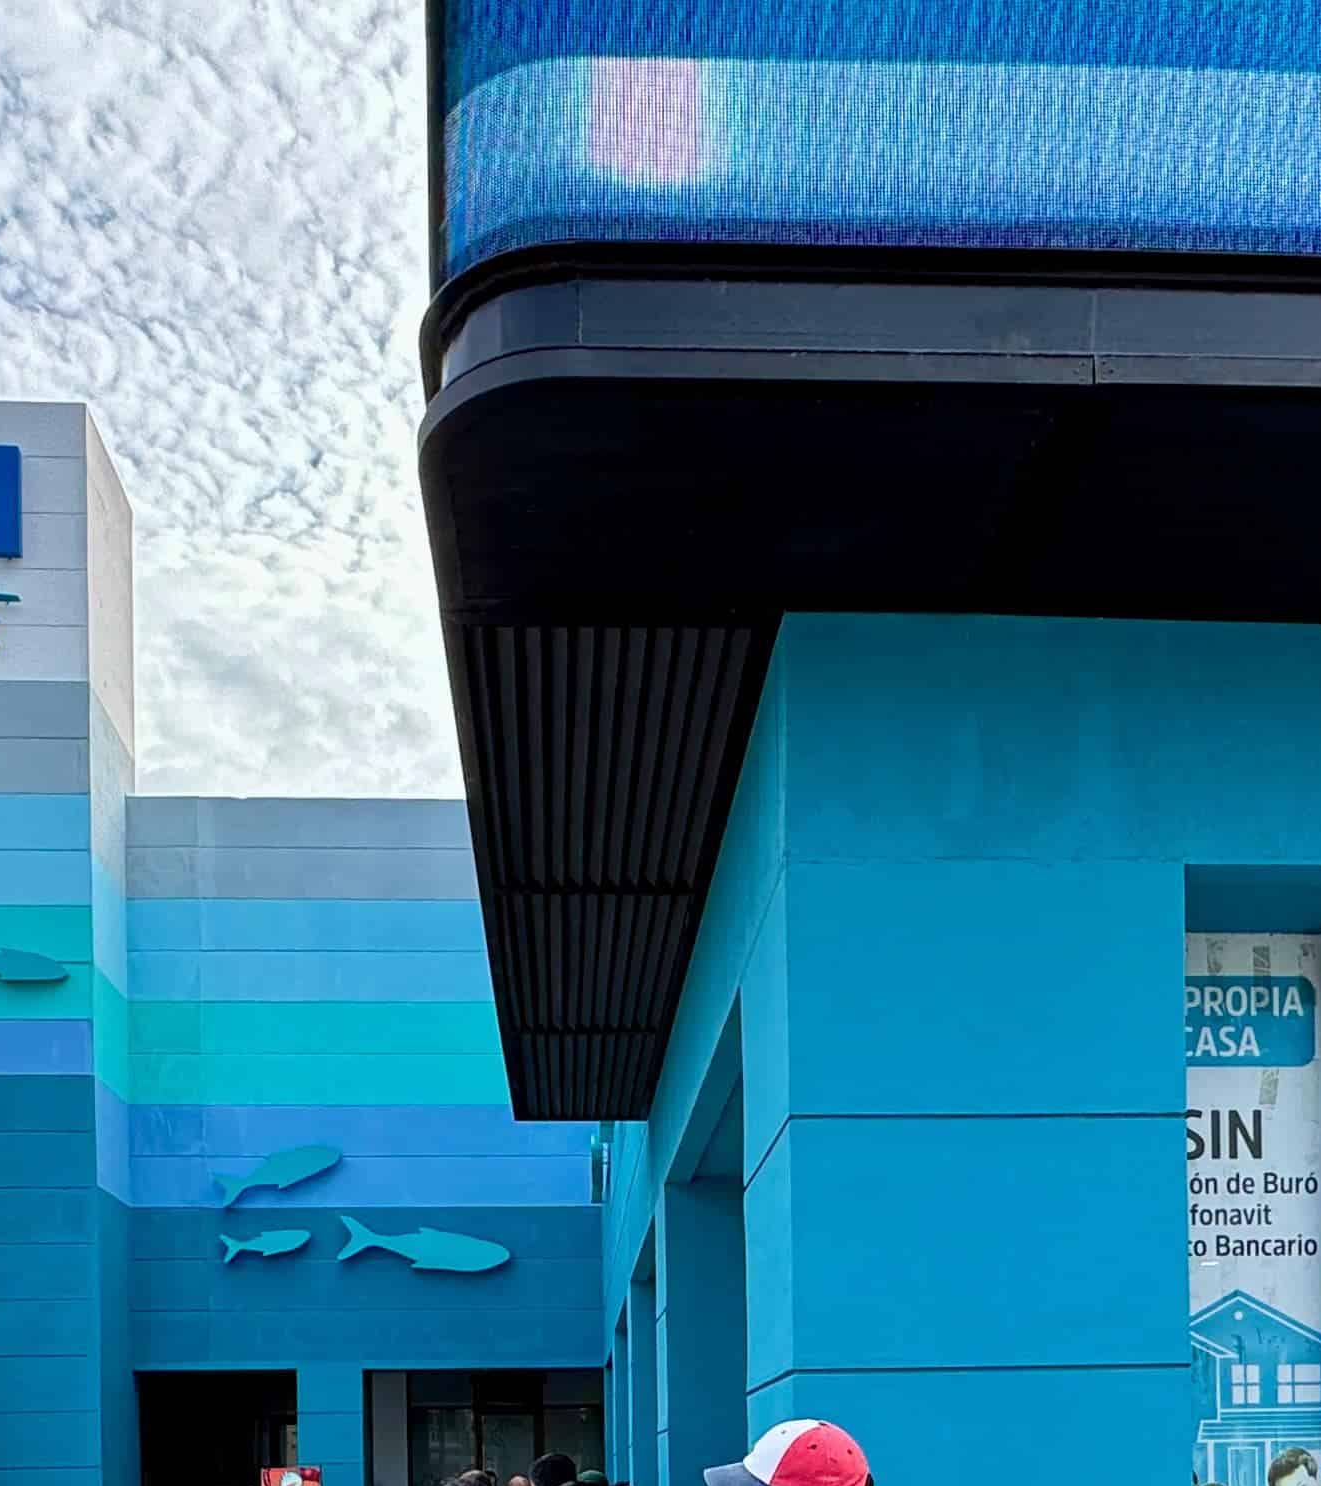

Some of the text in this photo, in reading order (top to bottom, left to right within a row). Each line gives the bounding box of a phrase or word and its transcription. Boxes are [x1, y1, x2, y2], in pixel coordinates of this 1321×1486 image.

[1226, 1172, 1255, 1195] de
[1263, 1172, 1319, 1195] Buró
[1215, 1234, 1318, 1257] Bancario
